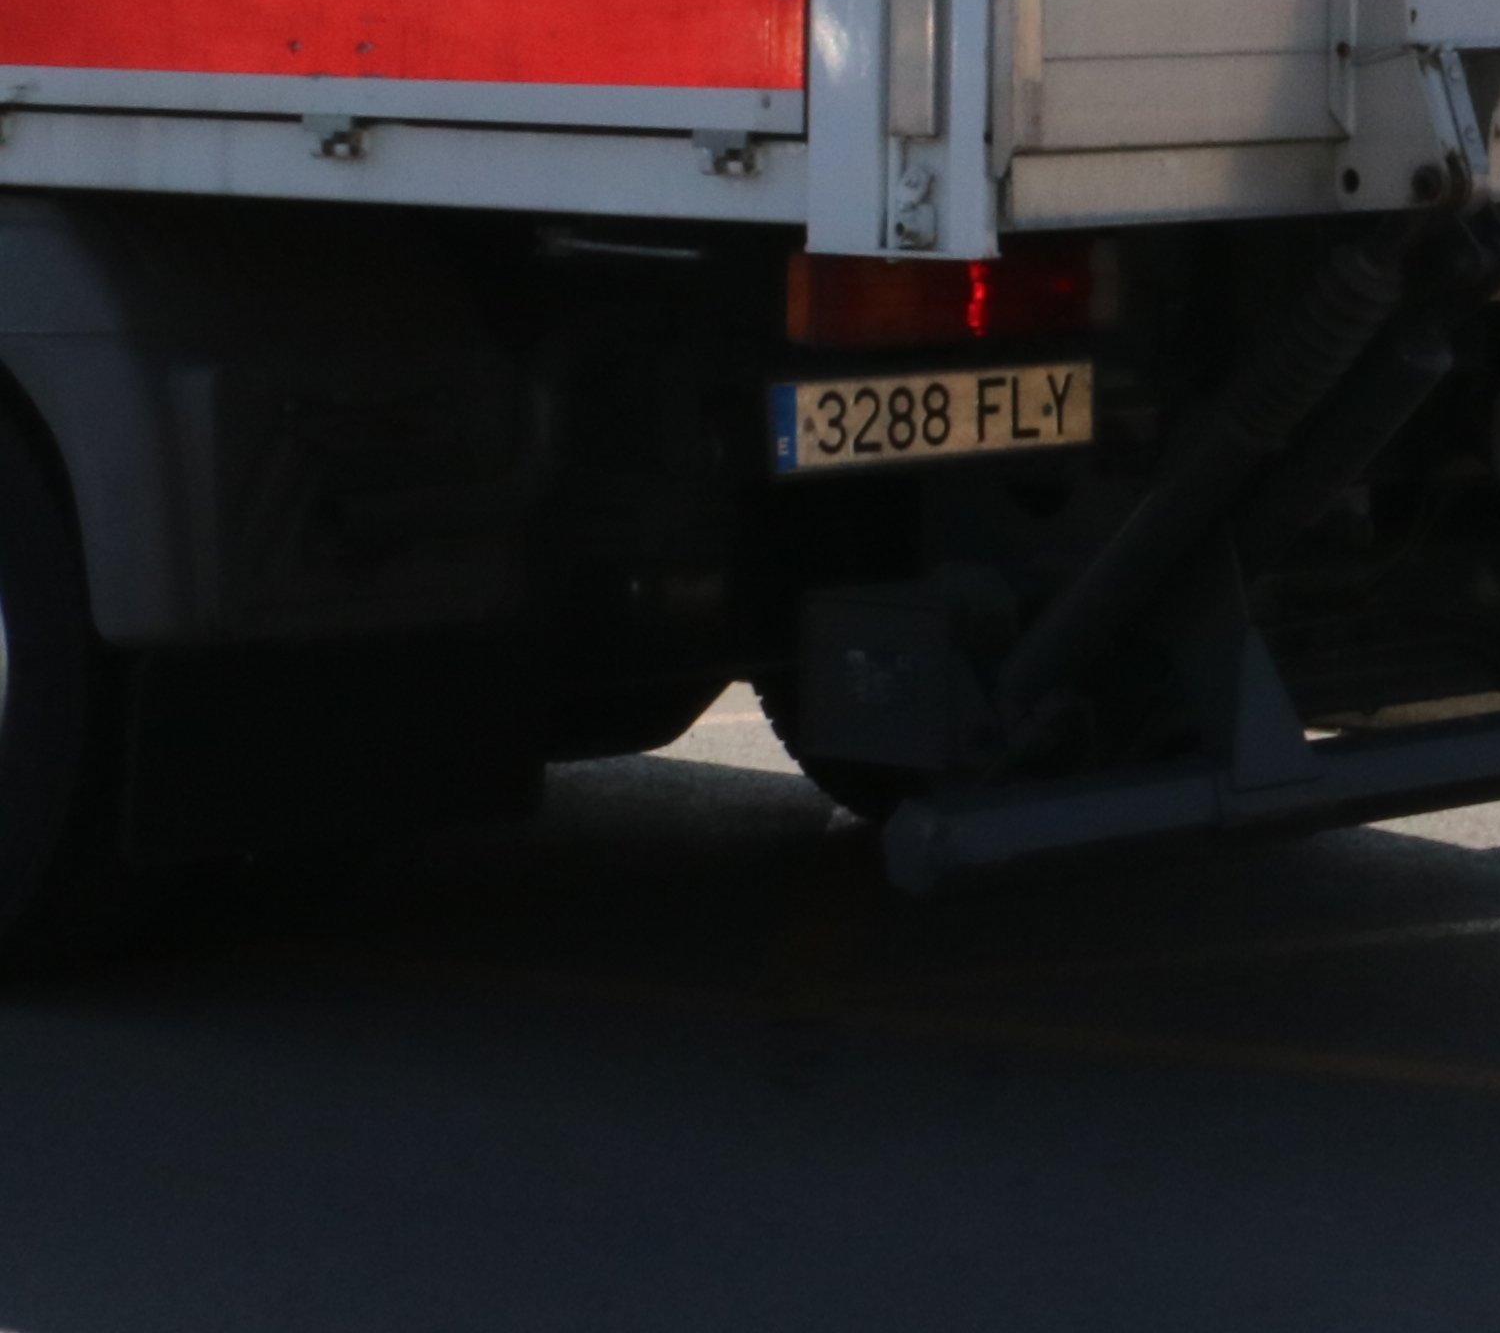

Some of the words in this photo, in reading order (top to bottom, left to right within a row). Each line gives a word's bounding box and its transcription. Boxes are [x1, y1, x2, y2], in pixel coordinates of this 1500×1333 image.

[817, 383, 950, 455] 3288
[976, 372, 1073, 444] FLY
[777, 437, 790, 456] E
